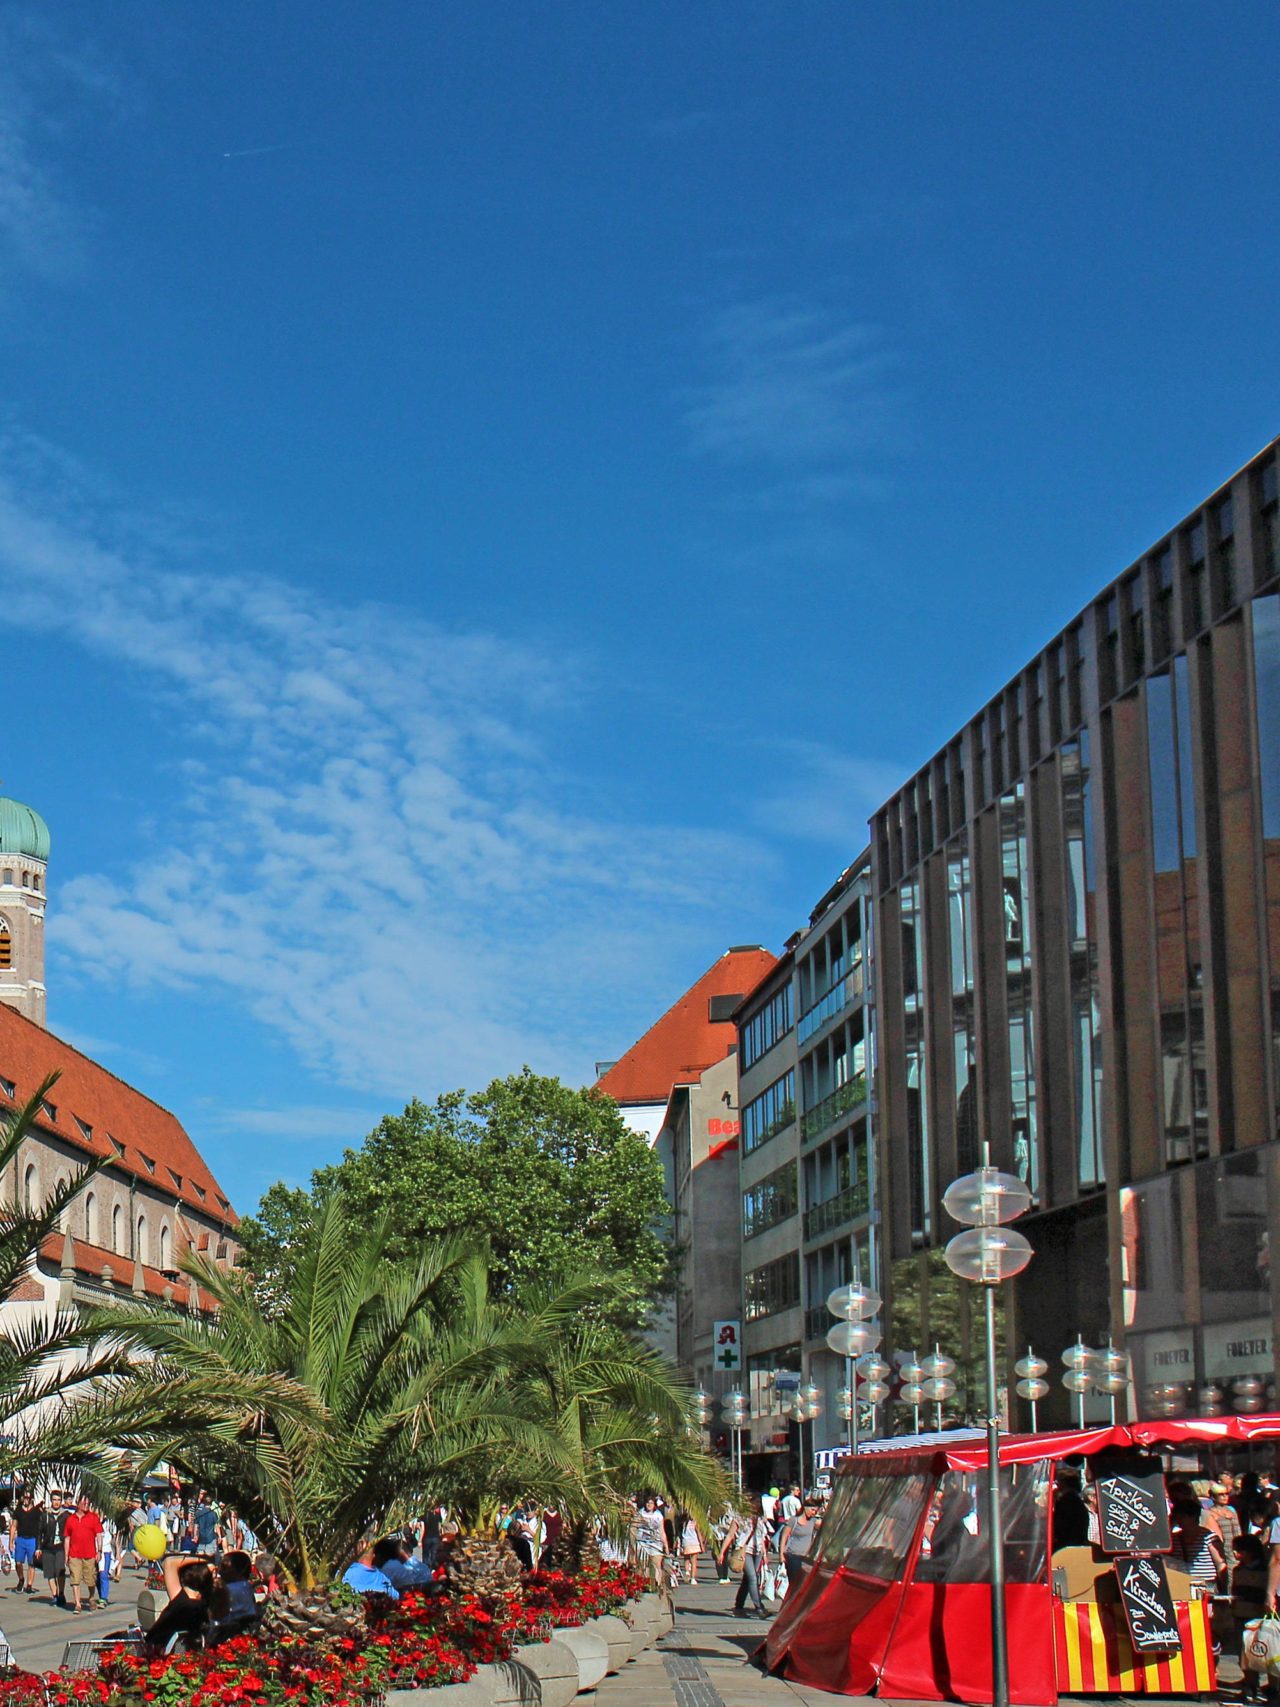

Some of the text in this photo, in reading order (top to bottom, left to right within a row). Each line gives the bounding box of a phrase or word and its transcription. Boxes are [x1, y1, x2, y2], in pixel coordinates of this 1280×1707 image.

[1227, 1339, 1267, 1357] FOREVER
[1154, 1349, 1189, 1366] FOREVER
[1123, 1565, 1167, 1618] Kirschen
